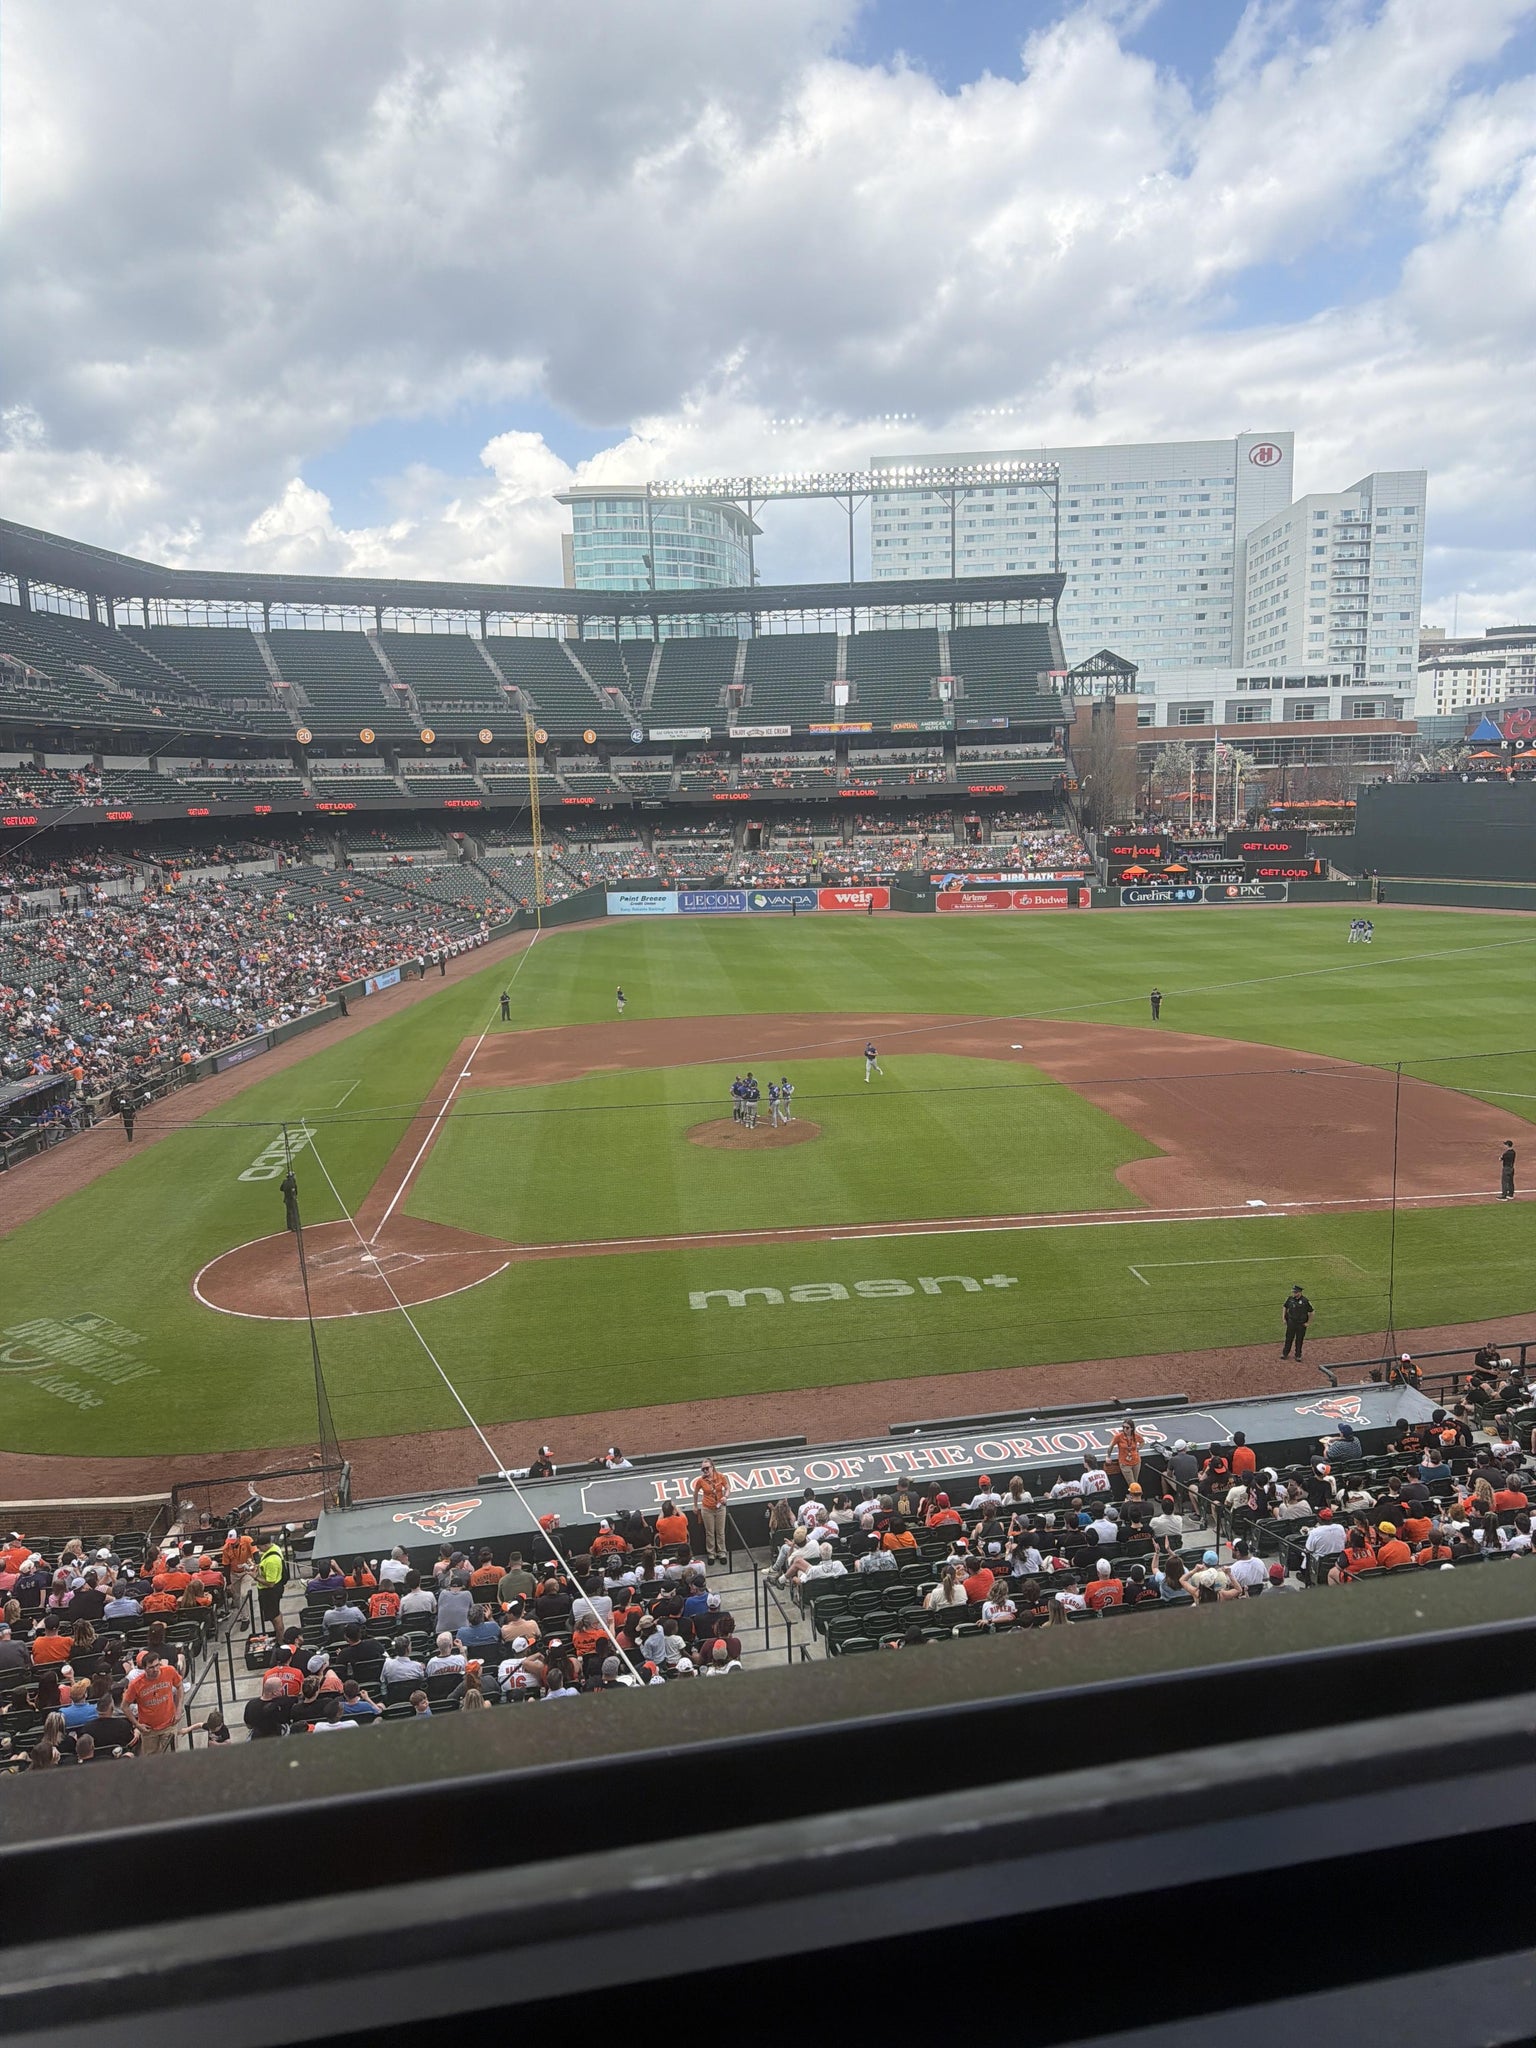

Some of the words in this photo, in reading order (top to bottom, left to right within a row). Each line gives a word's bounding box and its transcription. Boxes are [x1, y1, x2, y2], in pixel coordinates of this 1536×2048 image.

[841, 789, 855, 797] GET
[855, 789, 875, 797] LOUD
[6, 817, 18, 826] GET
[18, 816, 35, 825] LOUD
[1243, 843, 1261, 851] GET
[1000, 872, 1025, 881] BIRD
[1028, 872, 1054, 880] BATH
[1281, 869, 1308, 877] LOUD
[1129, 890, 1174, 902] CareFirst
[1240, 886, 1264, 896] PNC
[684, 894, 741, 906] LECOM
[767, 895, 812, 904] VANDA
[834, 890, 873, 903] weis
[962, 894, 987, 902] Airtemp
[803, 1456, 866, 1482] OF
[868, 1445, 973, 1475] THE
[1094, 1479, 1106, 1492] 12
[379, 1604, 387, 1616] 5
[511, 1675, 528, 1690] 16
